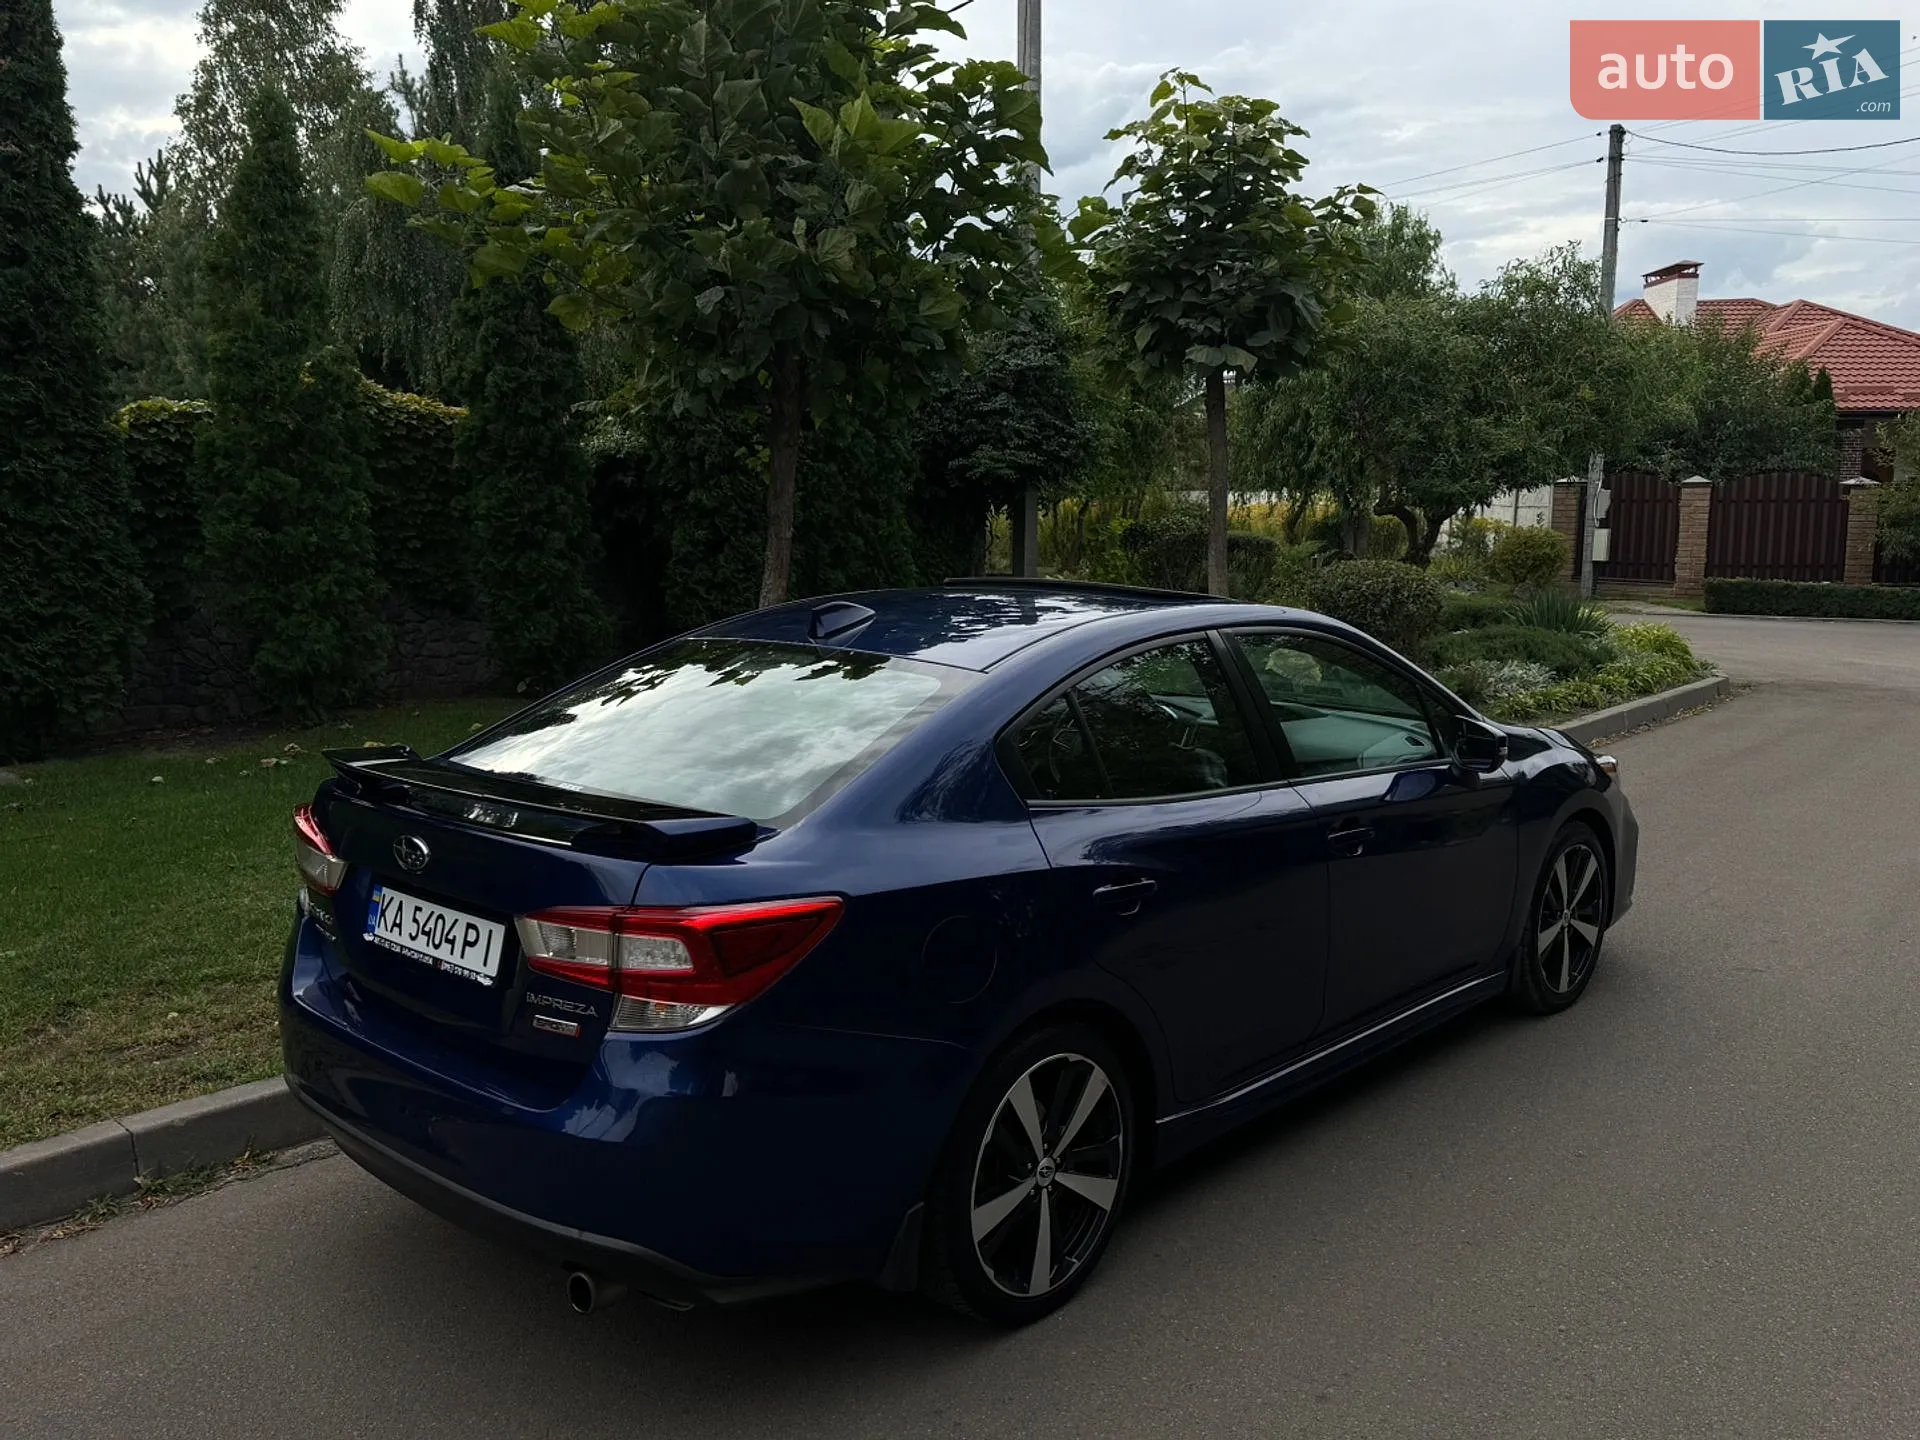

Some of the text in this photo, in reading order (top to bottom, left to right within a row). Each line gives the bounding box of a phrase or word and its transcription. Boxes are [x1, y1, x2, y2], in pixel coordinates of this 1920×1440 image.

[377, 893, 403, 937] KA
[408, 905, 459, 956] 5404
[460, 922, 493, 968] PI
[526, 991, 599, 1018] IMPREZA
